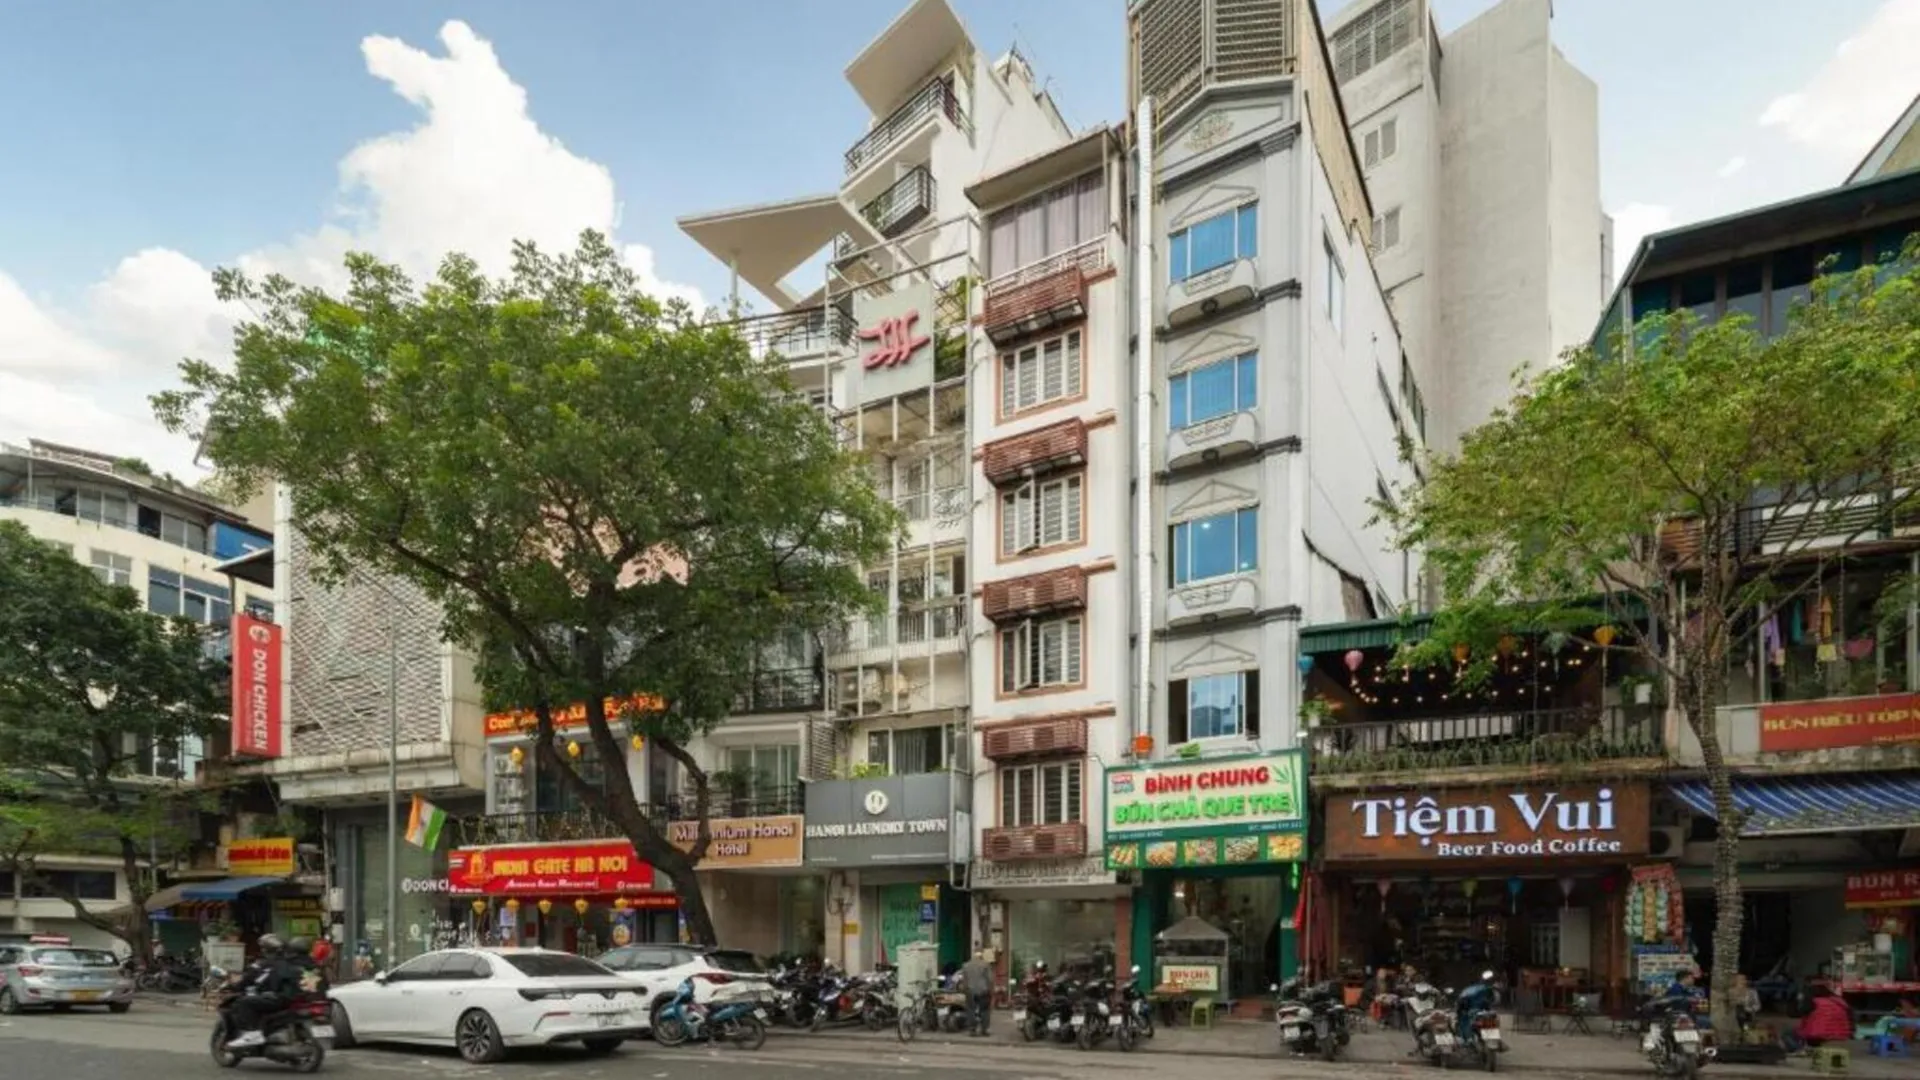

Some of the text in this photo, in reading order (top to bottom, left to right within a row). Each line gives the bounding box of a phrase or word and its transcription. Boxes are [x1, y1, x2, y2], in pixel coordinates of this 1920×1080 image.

[253, 648, 269, 750] DON CHICKEN
[1197, 766, 1270, 790] CHUNG
[1203, 796, 1245, 819] QUE
[1249, 792, 1293, 815] TRE
[1351, 788, 1615, 847] Tiệm Vui
[752, 823, 796, 838] Hanoi
[806, 818, 948, 838] HANOI LAUNDRY TOWN
[715, 842, 750, 855] Hotel
[1437, 837, 1622, 857] Beer Food Coffee
[533, 858, 571, 874] GATE
